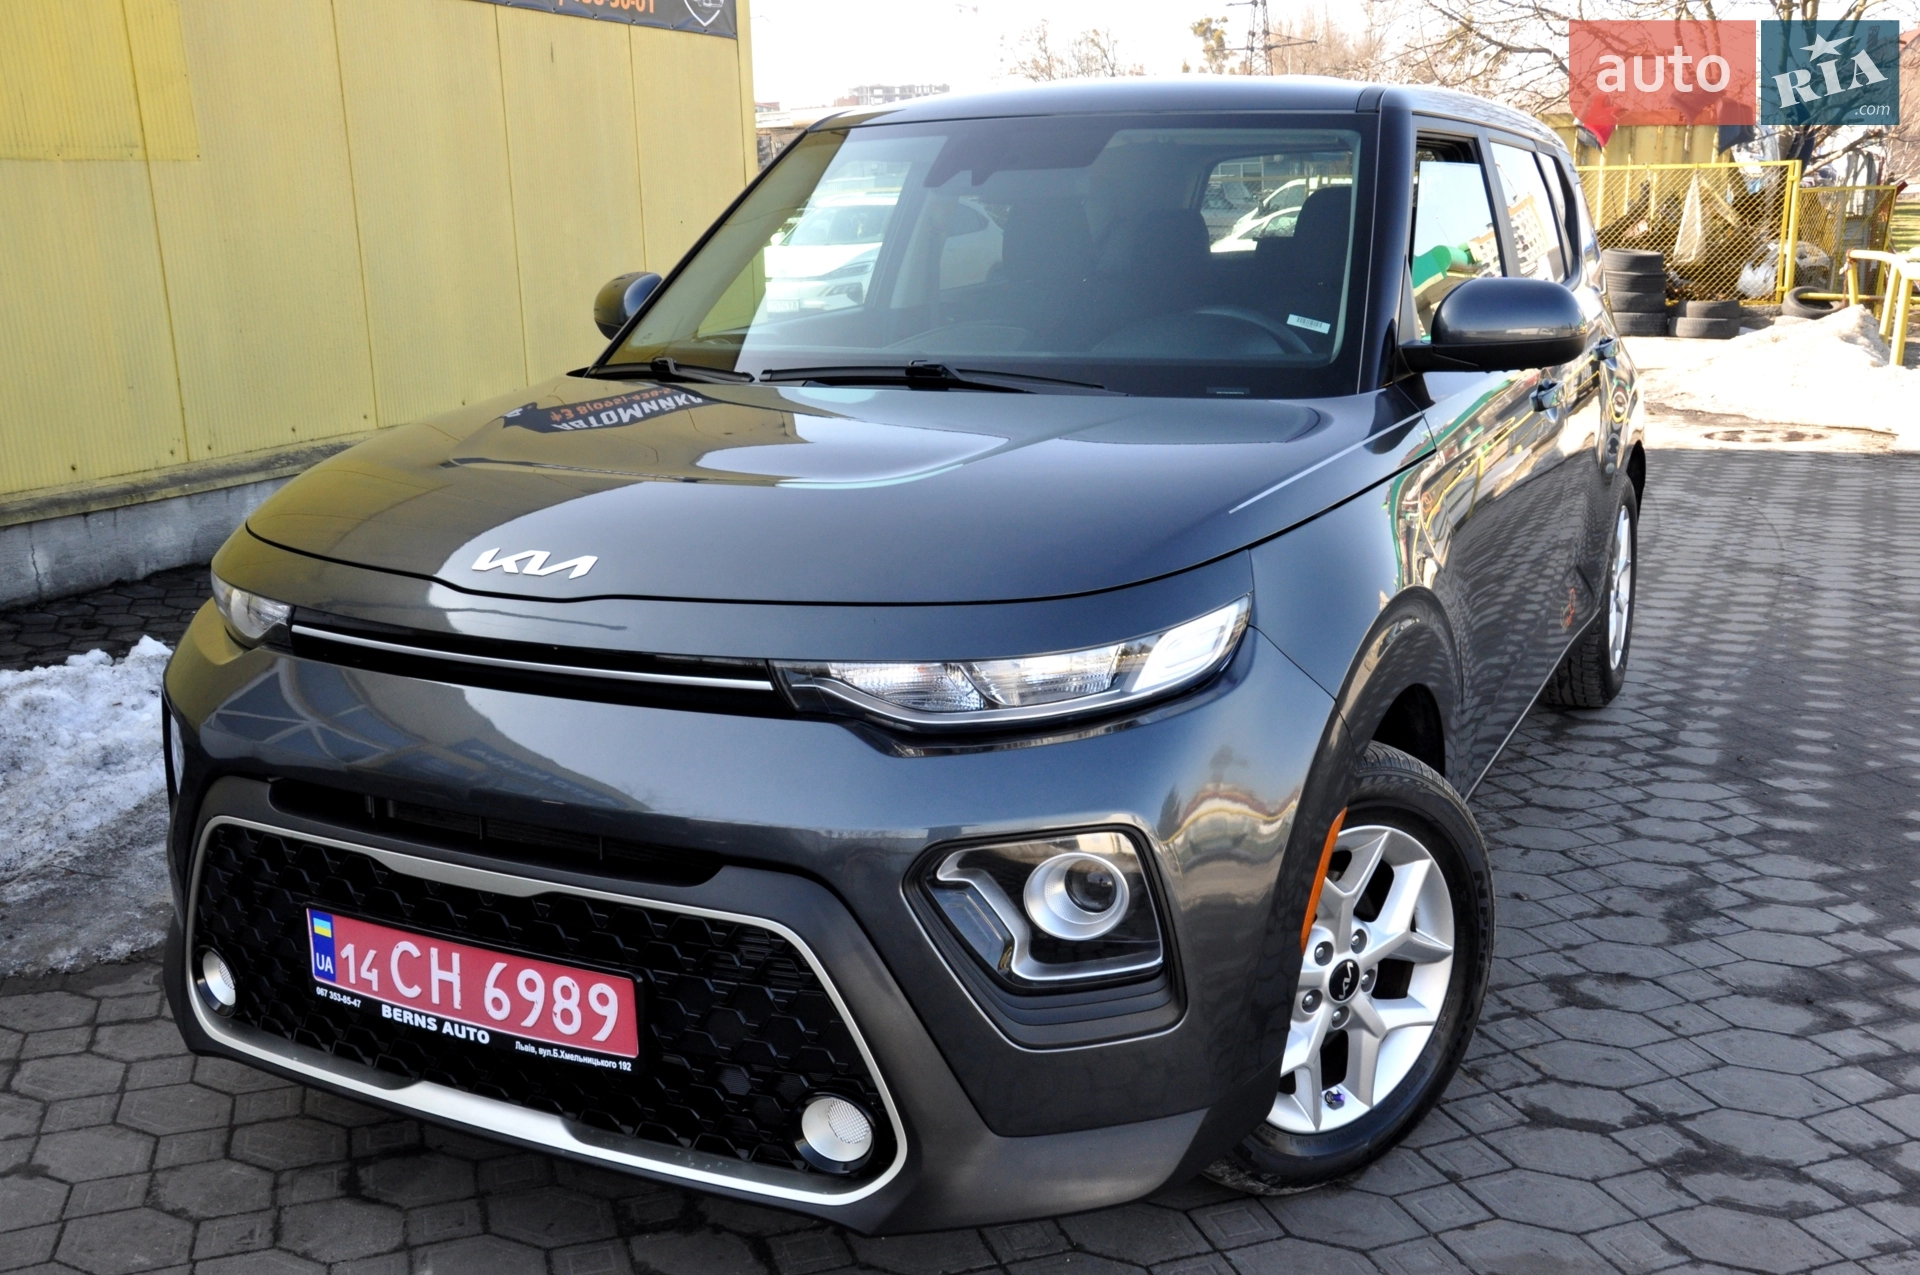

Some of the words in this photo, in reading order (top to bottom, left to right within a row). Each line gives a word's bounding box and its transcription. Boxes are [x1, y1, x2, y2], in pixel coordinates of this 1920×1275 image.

[471, 547, 599, 580] KIA
[316, 952, 334, 975] UA
[484, 962, 619, 1042] 6989
[381, 1003, 438, 1032] BERNS
[442, 1021, 490, 1045] AUTO
[618, 1060, 632, 1072] 192
